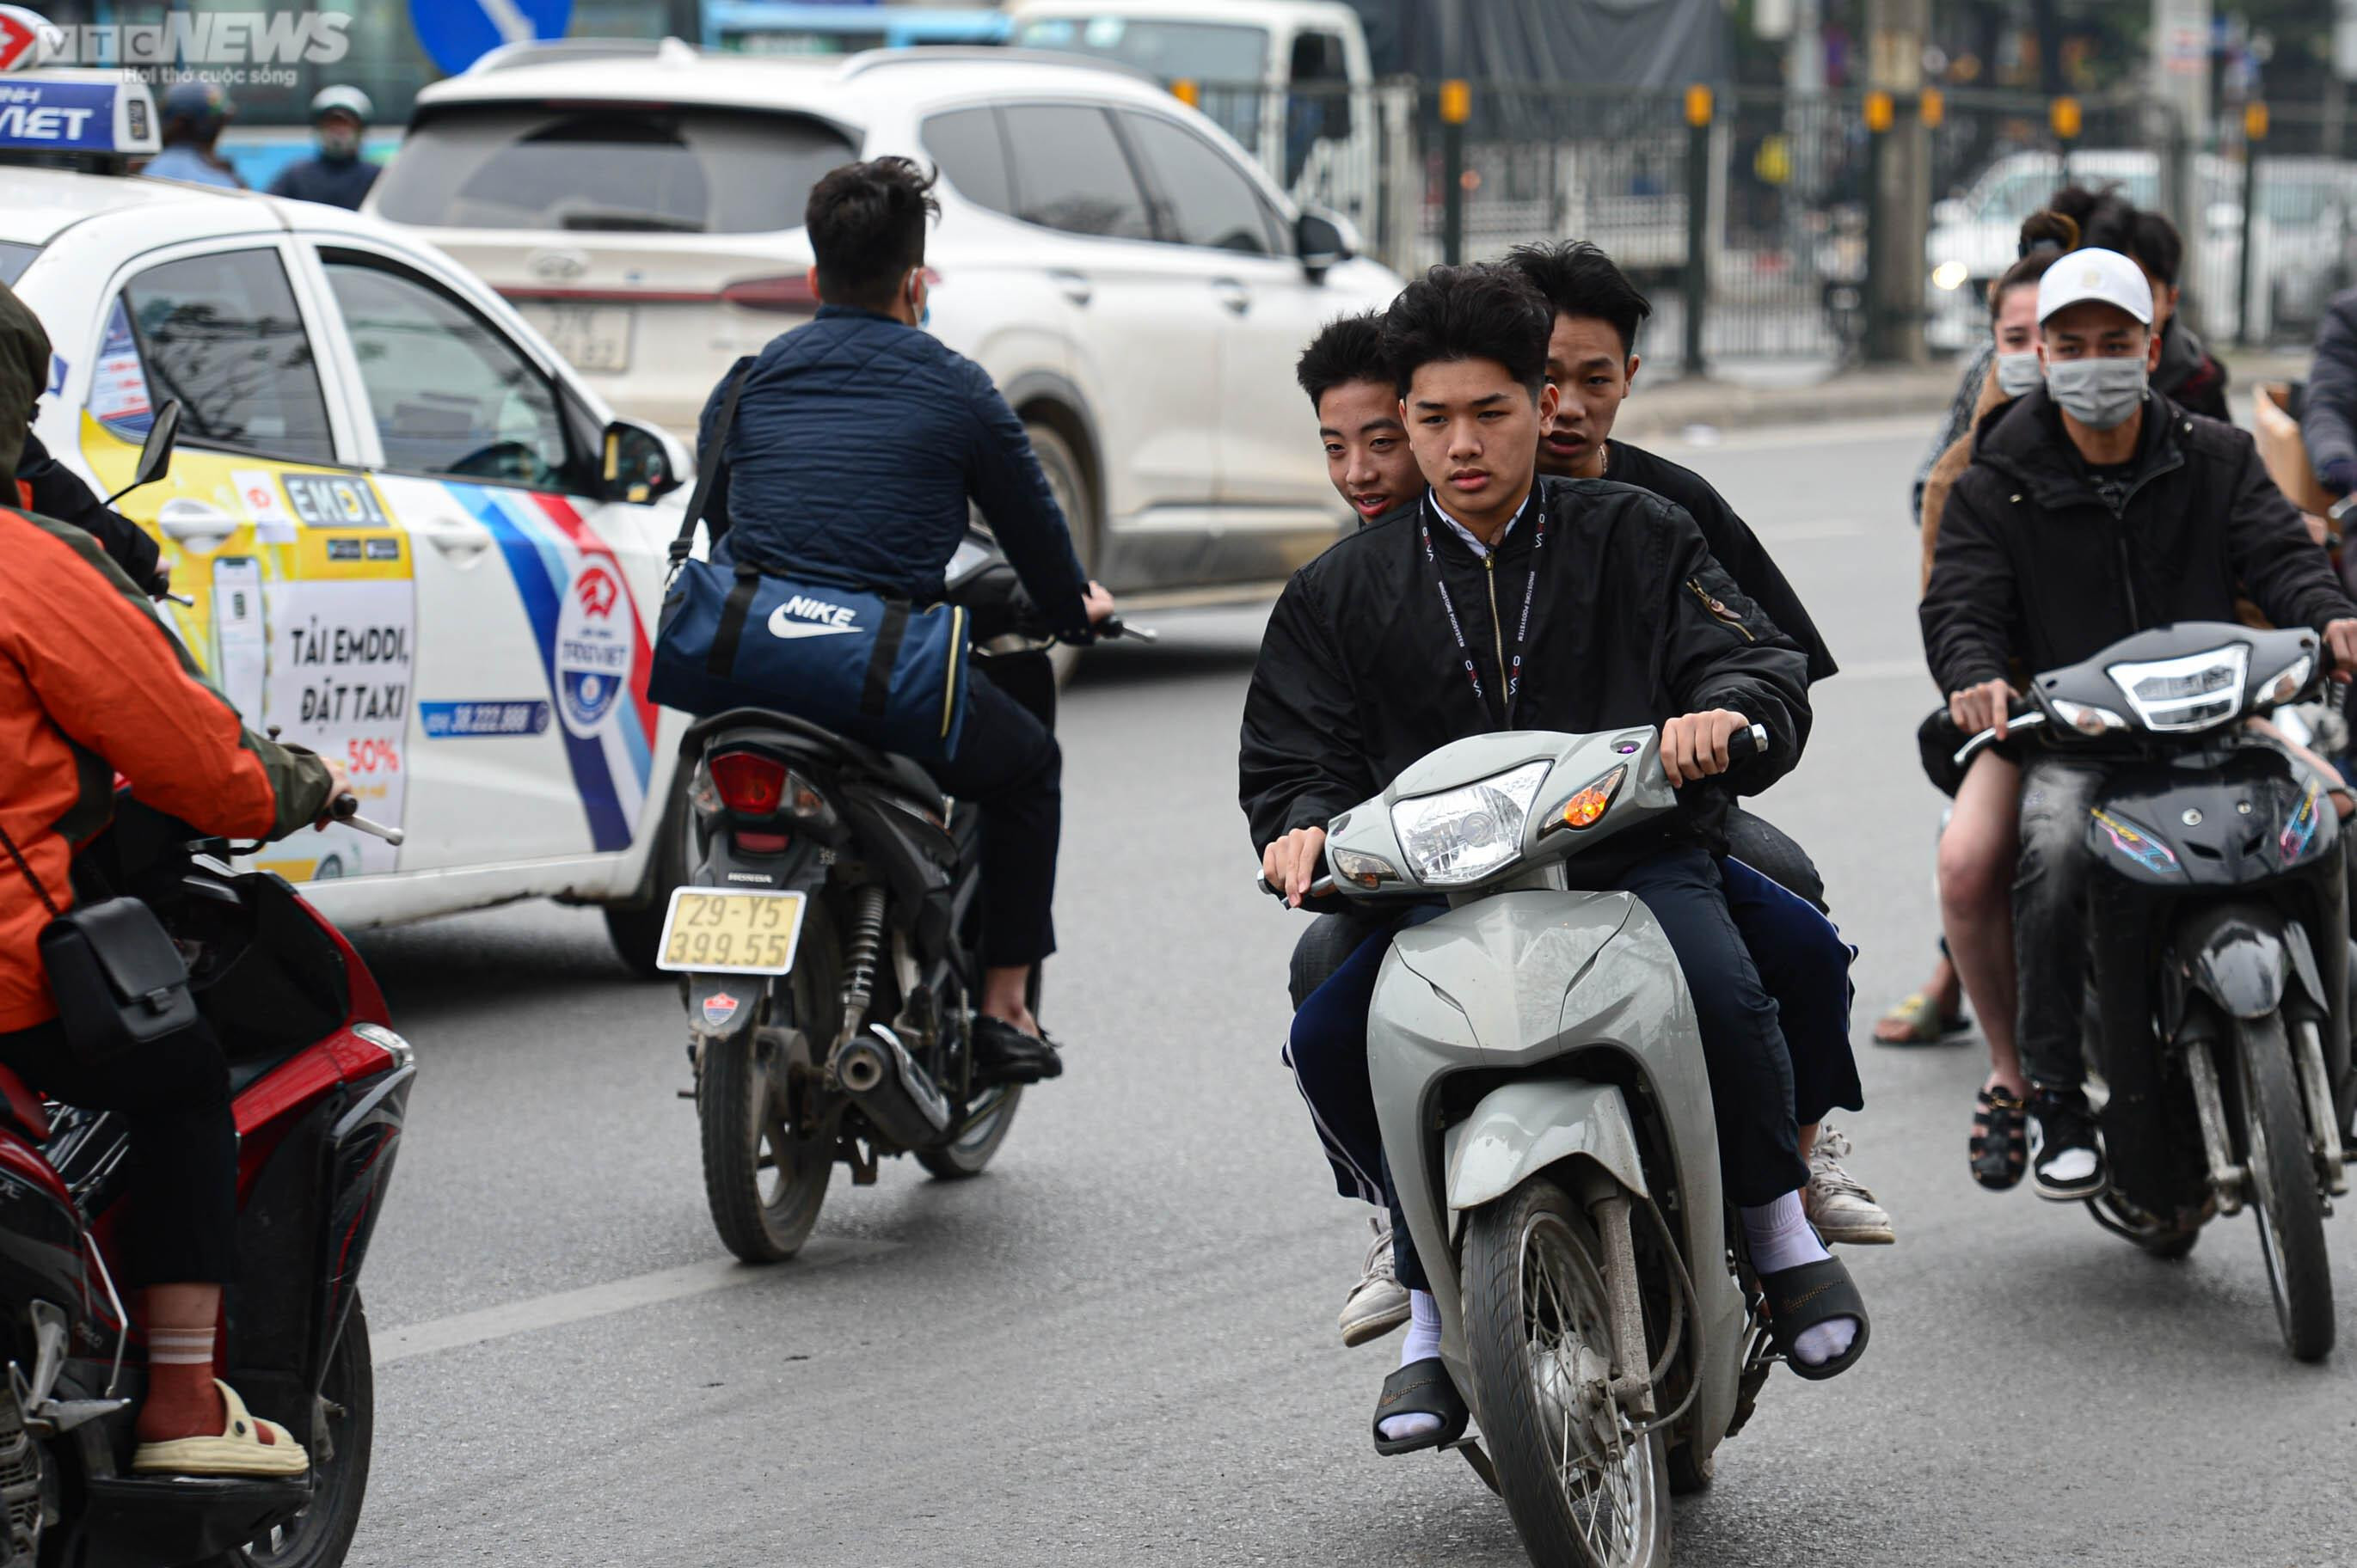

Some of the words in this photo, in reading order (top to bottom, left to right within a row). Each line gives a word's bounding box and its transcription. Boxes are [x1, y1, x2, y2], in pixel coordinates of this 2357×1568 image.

[783, 595, 856, 628] NIKE
[353, 683, 406, 721] TAXI
[348, 738, 400, 773] 50%
[727, 873, 773, 883] HONDA
[688, 897, 782, 929] 29-Y5
[670, 932, 786, 966] 399.55
